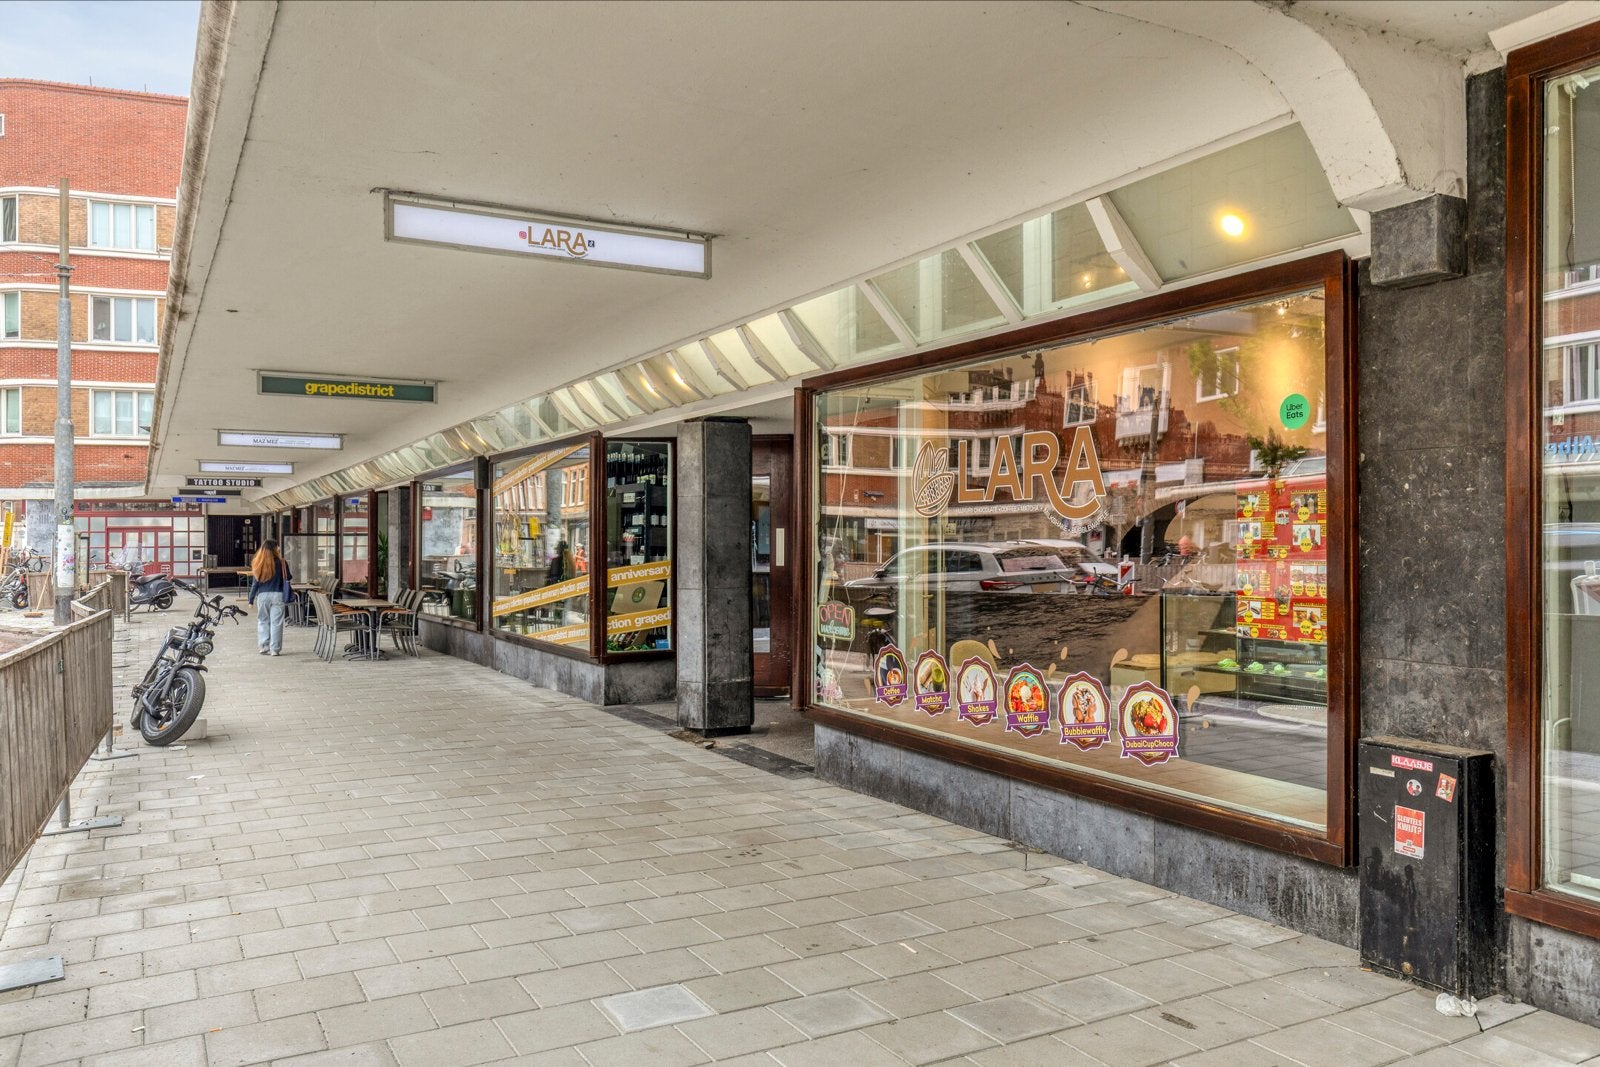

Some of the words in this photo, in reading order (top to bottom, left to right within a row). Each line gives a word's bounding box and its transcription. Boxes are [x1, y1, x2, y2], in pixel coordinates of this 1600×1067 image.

[528, 226, 588, 256] LARA
[305, 381, 394, 397] grapedistrict
[1286, 403, 1303, 411] Uber
[1286, 411, 1304, 419] Eats
[958, 425, 1107, 519] LARA
[226, 479, 255, 487] STUDIO
[611, 565, 671, 582] anniversary
[820, 603, 851, 627] OPEN
[882, 687, 901, 696] Coffee
[921, 695, 943, 704] Matcha
[967, 703, 990, 713] Shakes
[1016, 713, 1039, 724] Waffle
[1064, 725, 1108, 736] Bubblewaffle
[1125, 738, 1175, 750] DubaiCupChoco
